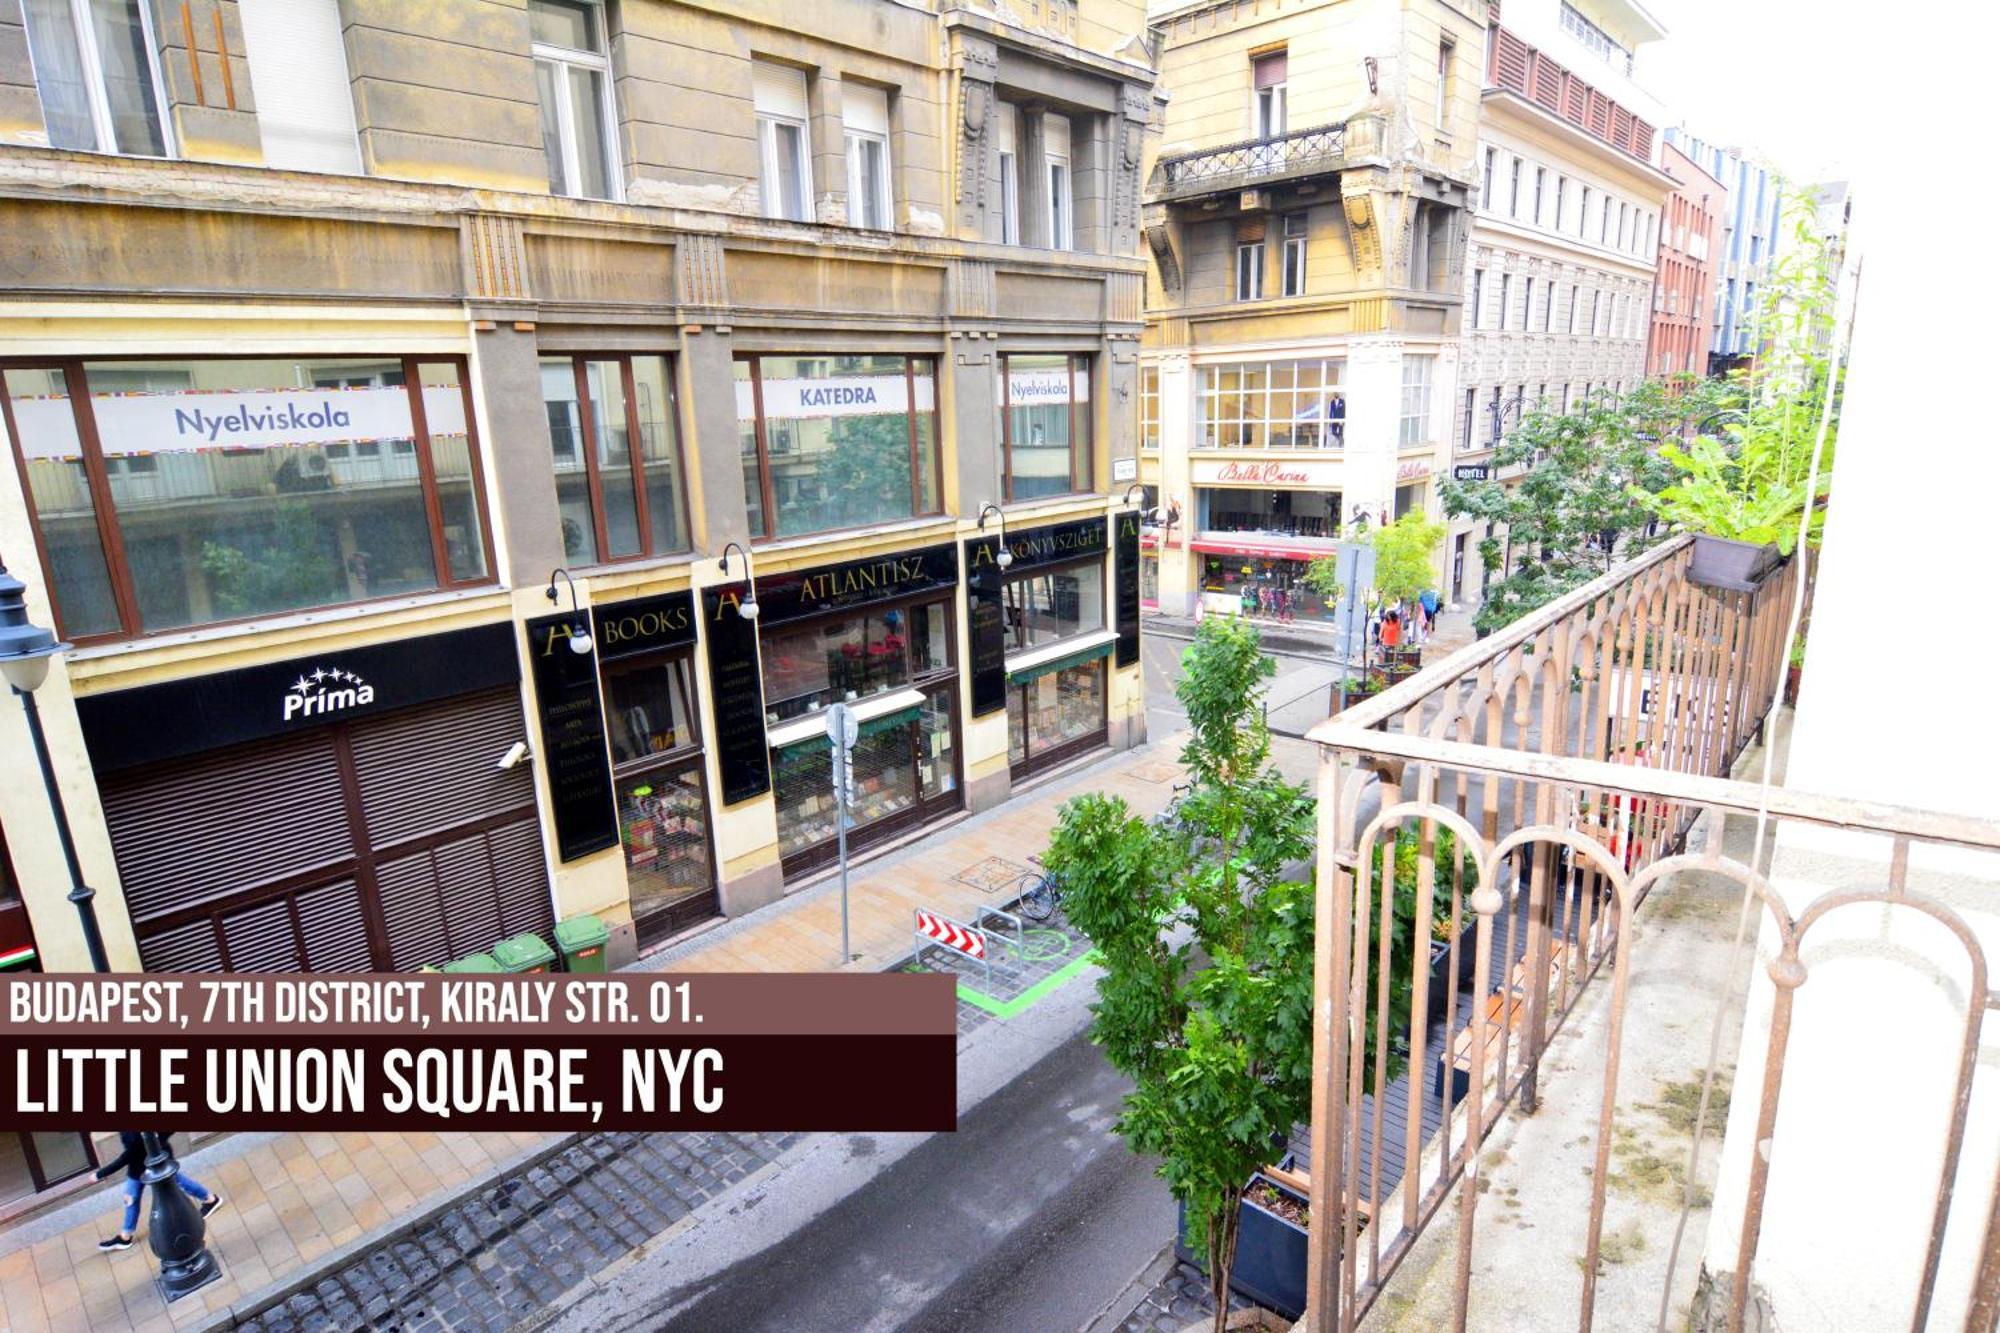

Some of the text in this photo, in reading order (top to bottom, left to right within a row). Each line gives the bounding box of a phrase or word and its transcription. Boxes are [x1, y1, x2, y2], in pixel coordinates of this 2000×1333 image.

[799, 385, 877, 407] KATEDRA
[1011, 379, 1068, 400] Nyelviskola
[174, 401, 351, 442] Nyelviskola
[1457, 468, 1485, 479] HOTEL
[975, 543, 994, 567] A
[799, 555, 926, 603] ATLANTISZ
[603, 606, 689, 645] BOOKS
